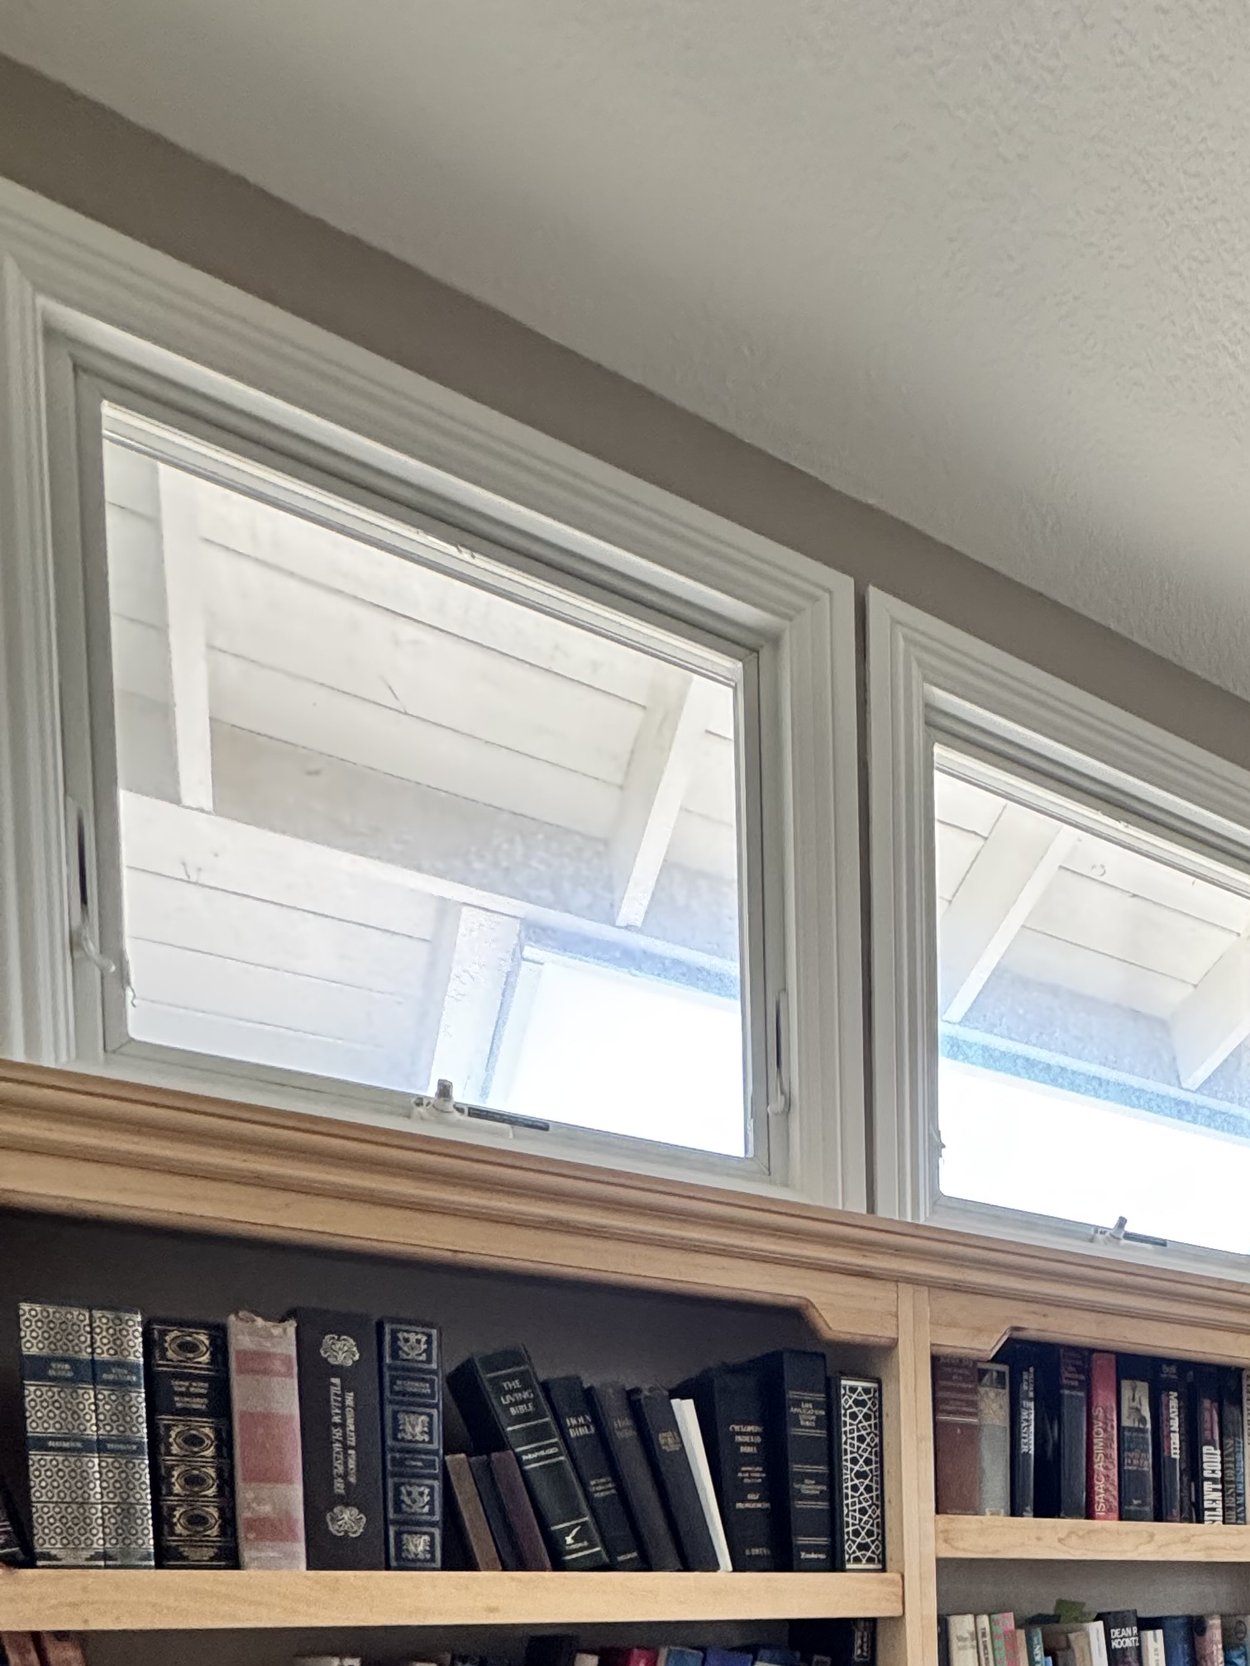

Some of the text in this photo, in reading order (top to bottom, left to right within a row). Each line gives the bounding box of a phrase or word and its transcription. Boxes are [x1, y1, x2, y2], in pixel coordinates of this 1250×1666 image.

[503, 1379, 521, 1389] THE
[501, 1391, 534, 1404] LIVING
[509, 1403, 534, 1416] BIBLE
[1202, 1445, 1223, 1525] SILENT COUP
[1095, 1473, 1107, 1516] ISAAC
[1110, 1627, 1132, 1638] DEAN
[1111, 1637, 1139, 1649] KOONTZ
